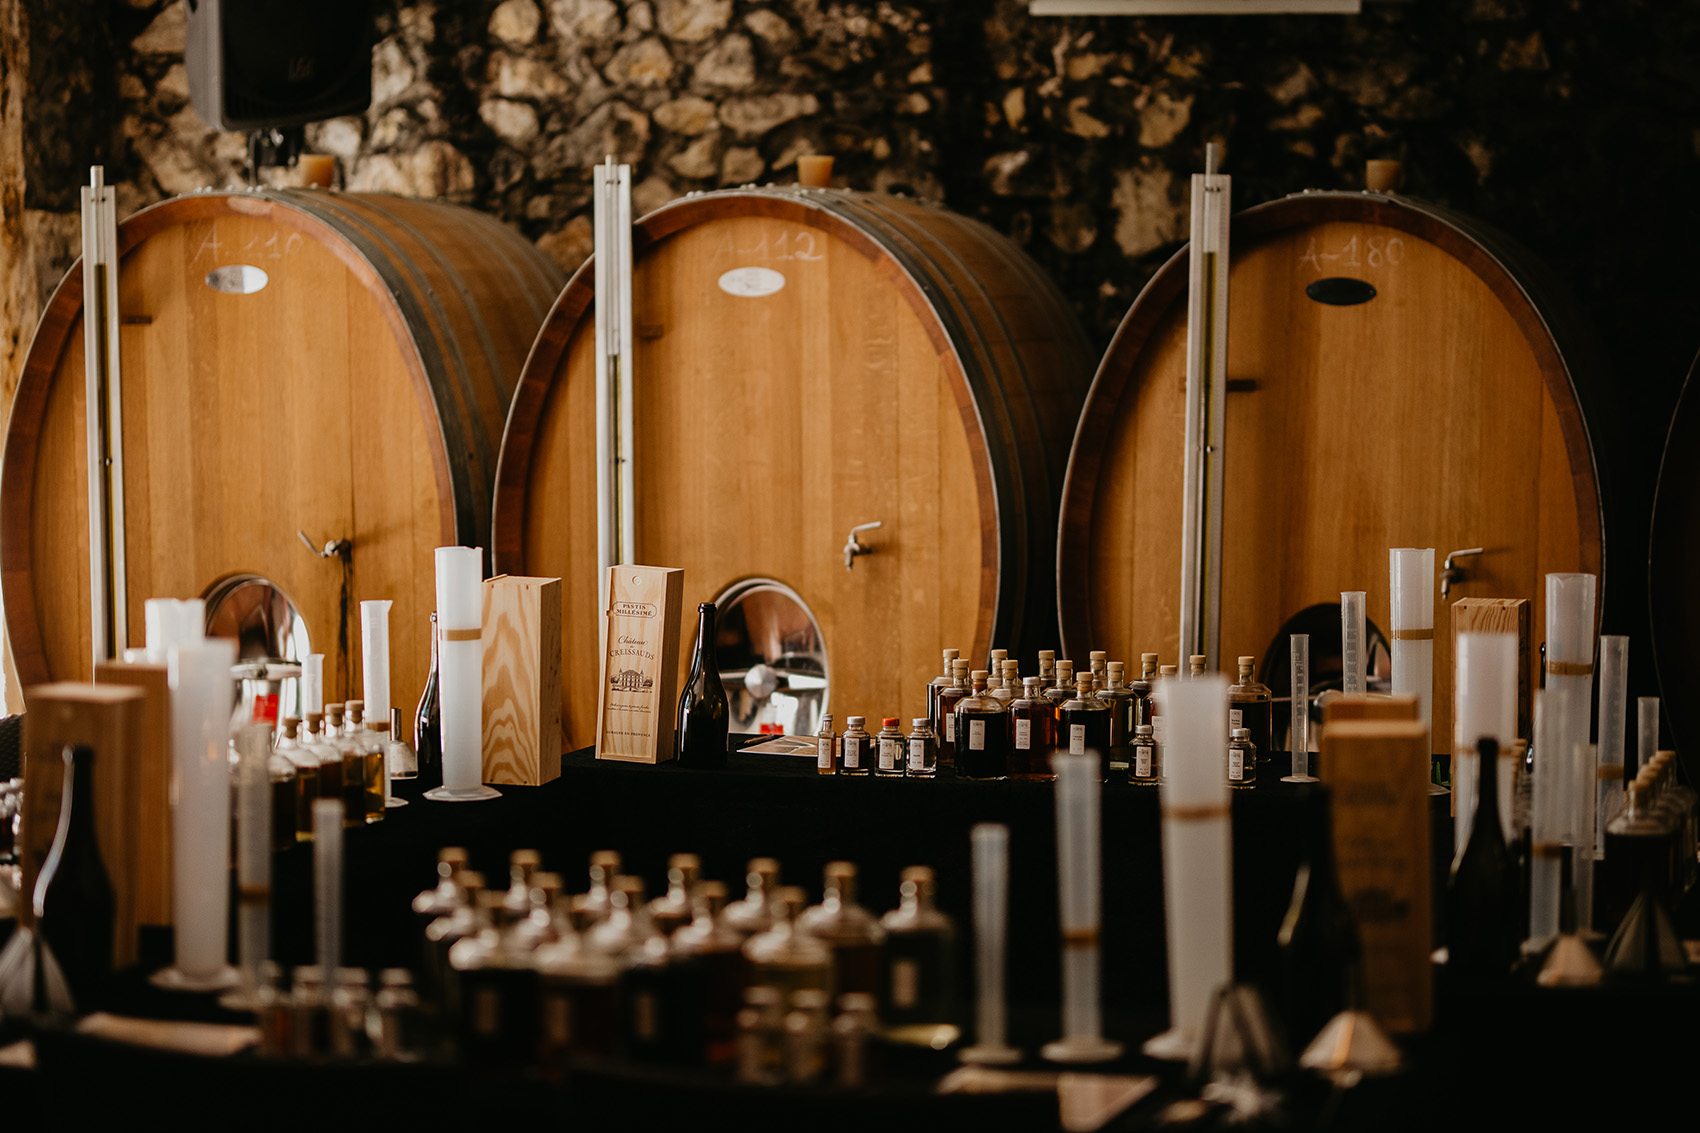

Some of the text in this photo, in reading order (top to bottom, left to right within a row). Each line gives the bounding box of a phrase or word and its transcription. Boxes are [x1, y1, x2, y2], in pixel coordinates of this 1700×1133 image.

[711, 229, 824, 265] A-112
[1296, 234, 1405, 272] A-180
[617, 635, 648, 645] Château
[609, 648, 655, 661] CREISSAUDS
